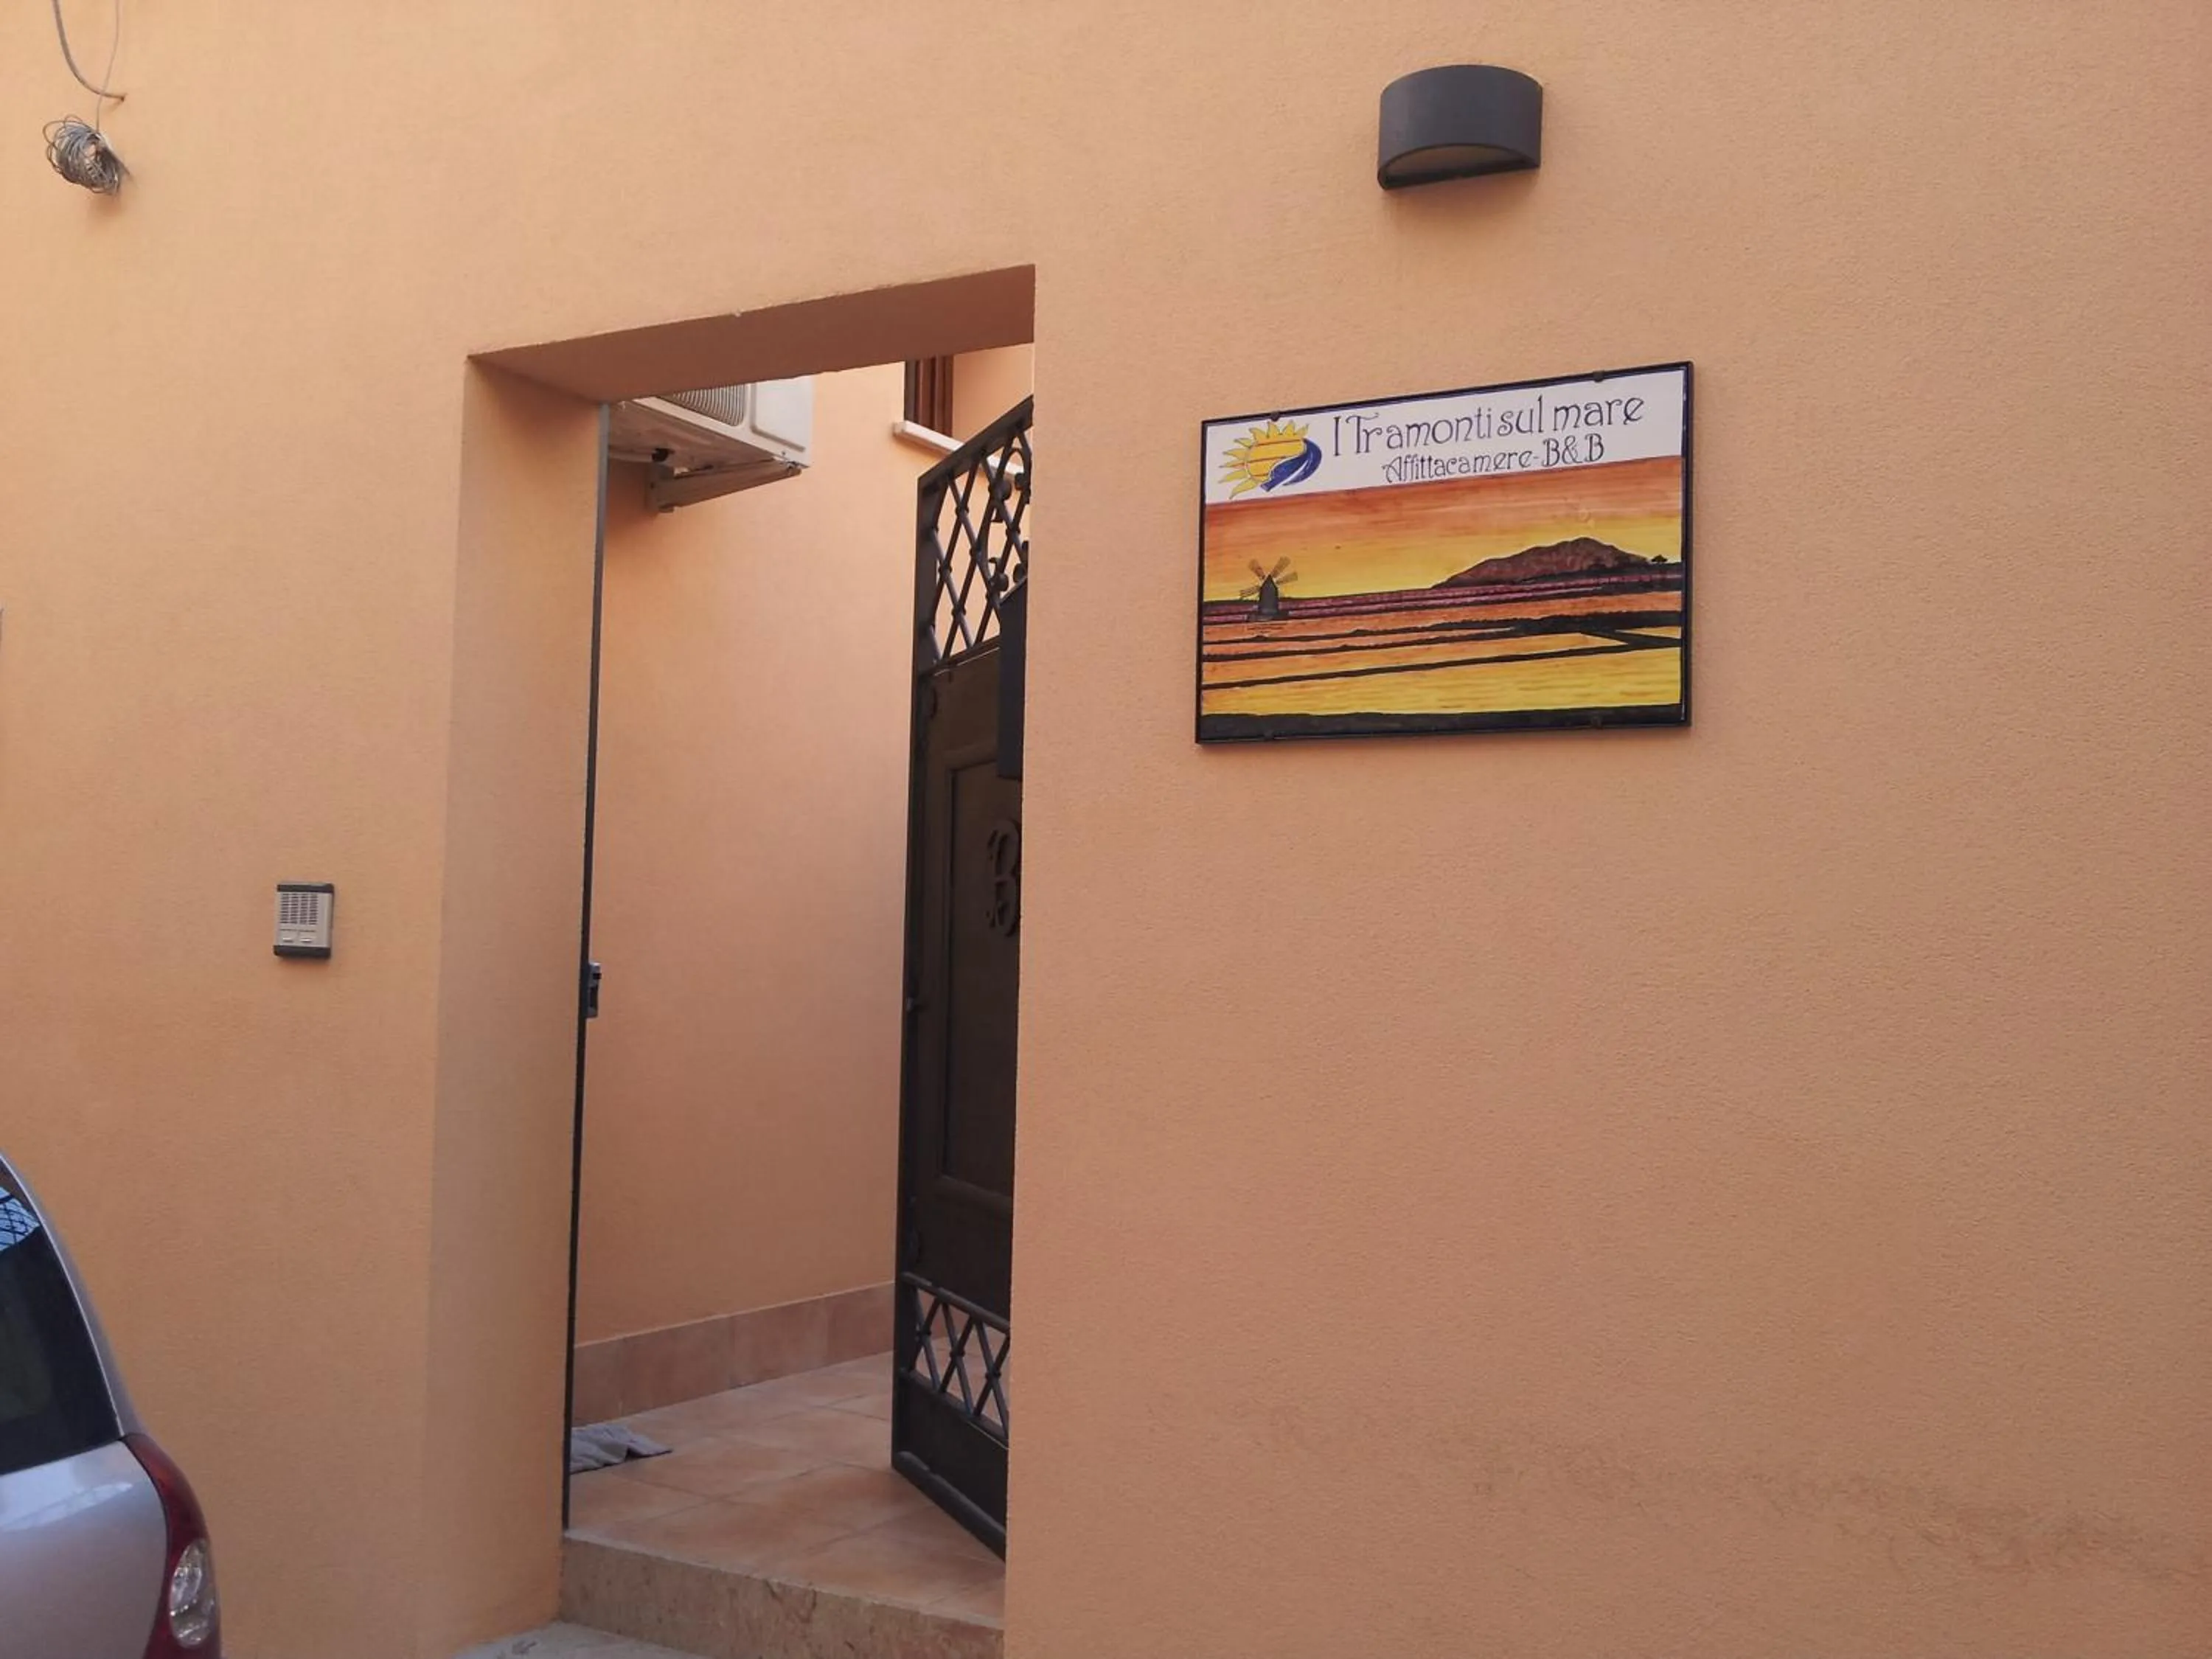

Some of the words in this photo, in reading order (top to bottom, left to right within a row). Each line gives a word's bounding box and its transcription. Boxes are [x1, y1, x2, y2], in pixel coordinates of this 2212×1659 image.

[1333, 415, 1342, 456] I
[1345, 406, 1492, 454] Tramonti
[1496, 394, 1544, 437] sul
[1552, 397, 1645, 434] mare
